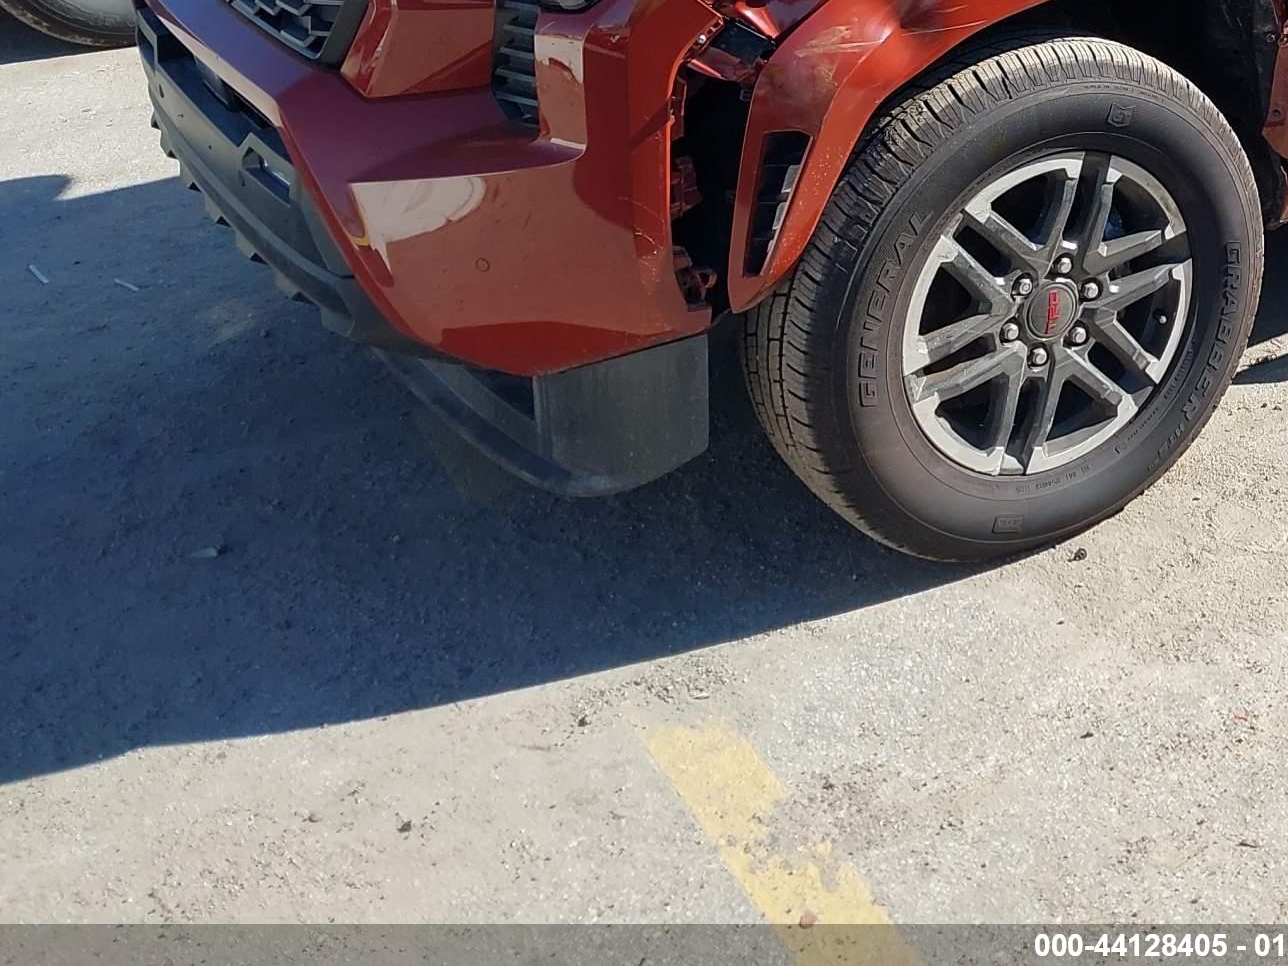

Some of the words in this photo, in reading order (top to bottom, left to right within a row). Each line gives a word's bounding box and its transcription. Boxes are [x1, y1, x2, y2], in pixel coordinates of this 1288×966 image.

[858, 209, 933, 409] GENERAL
[1044, 288, 1060, 334] TRD
[1180, 241, 1243, 422] GRABBER
